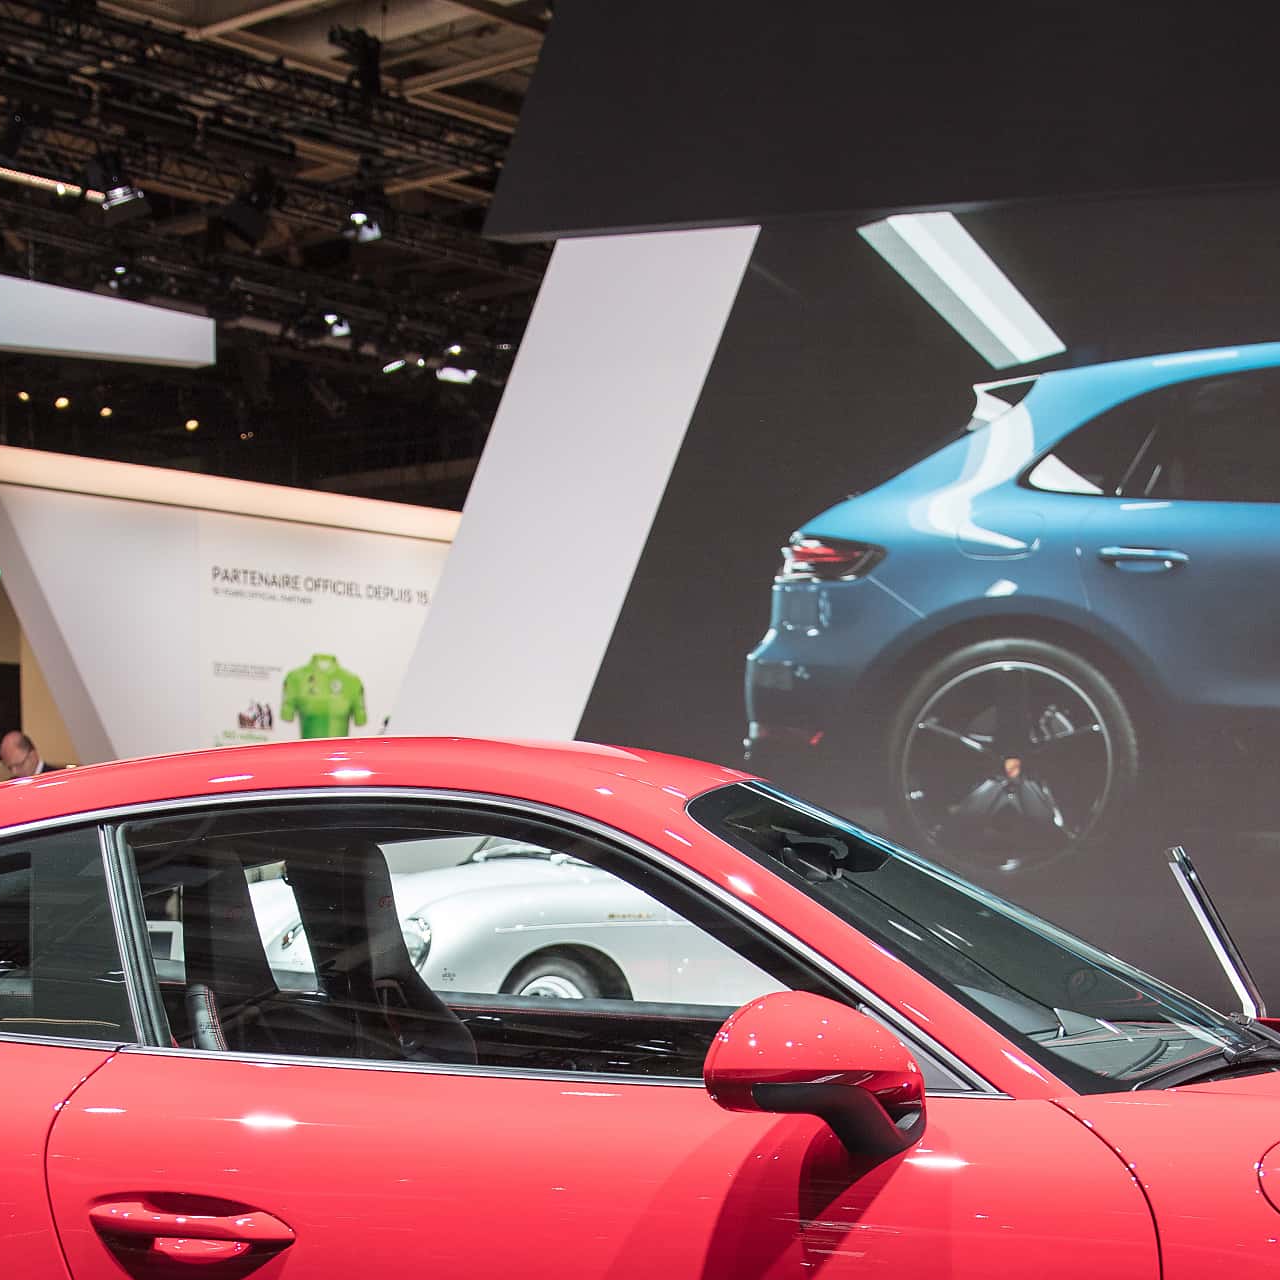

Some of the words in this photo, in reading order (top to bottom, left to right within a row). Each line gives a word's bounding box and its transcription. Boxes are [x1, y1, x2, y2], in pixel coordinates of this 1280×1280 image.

[211, 565, 300, 592] PARTENAIRE
[303, 576, 363, 600] OFFICIEL
[366, 583, 412, 605] DEPUIS
